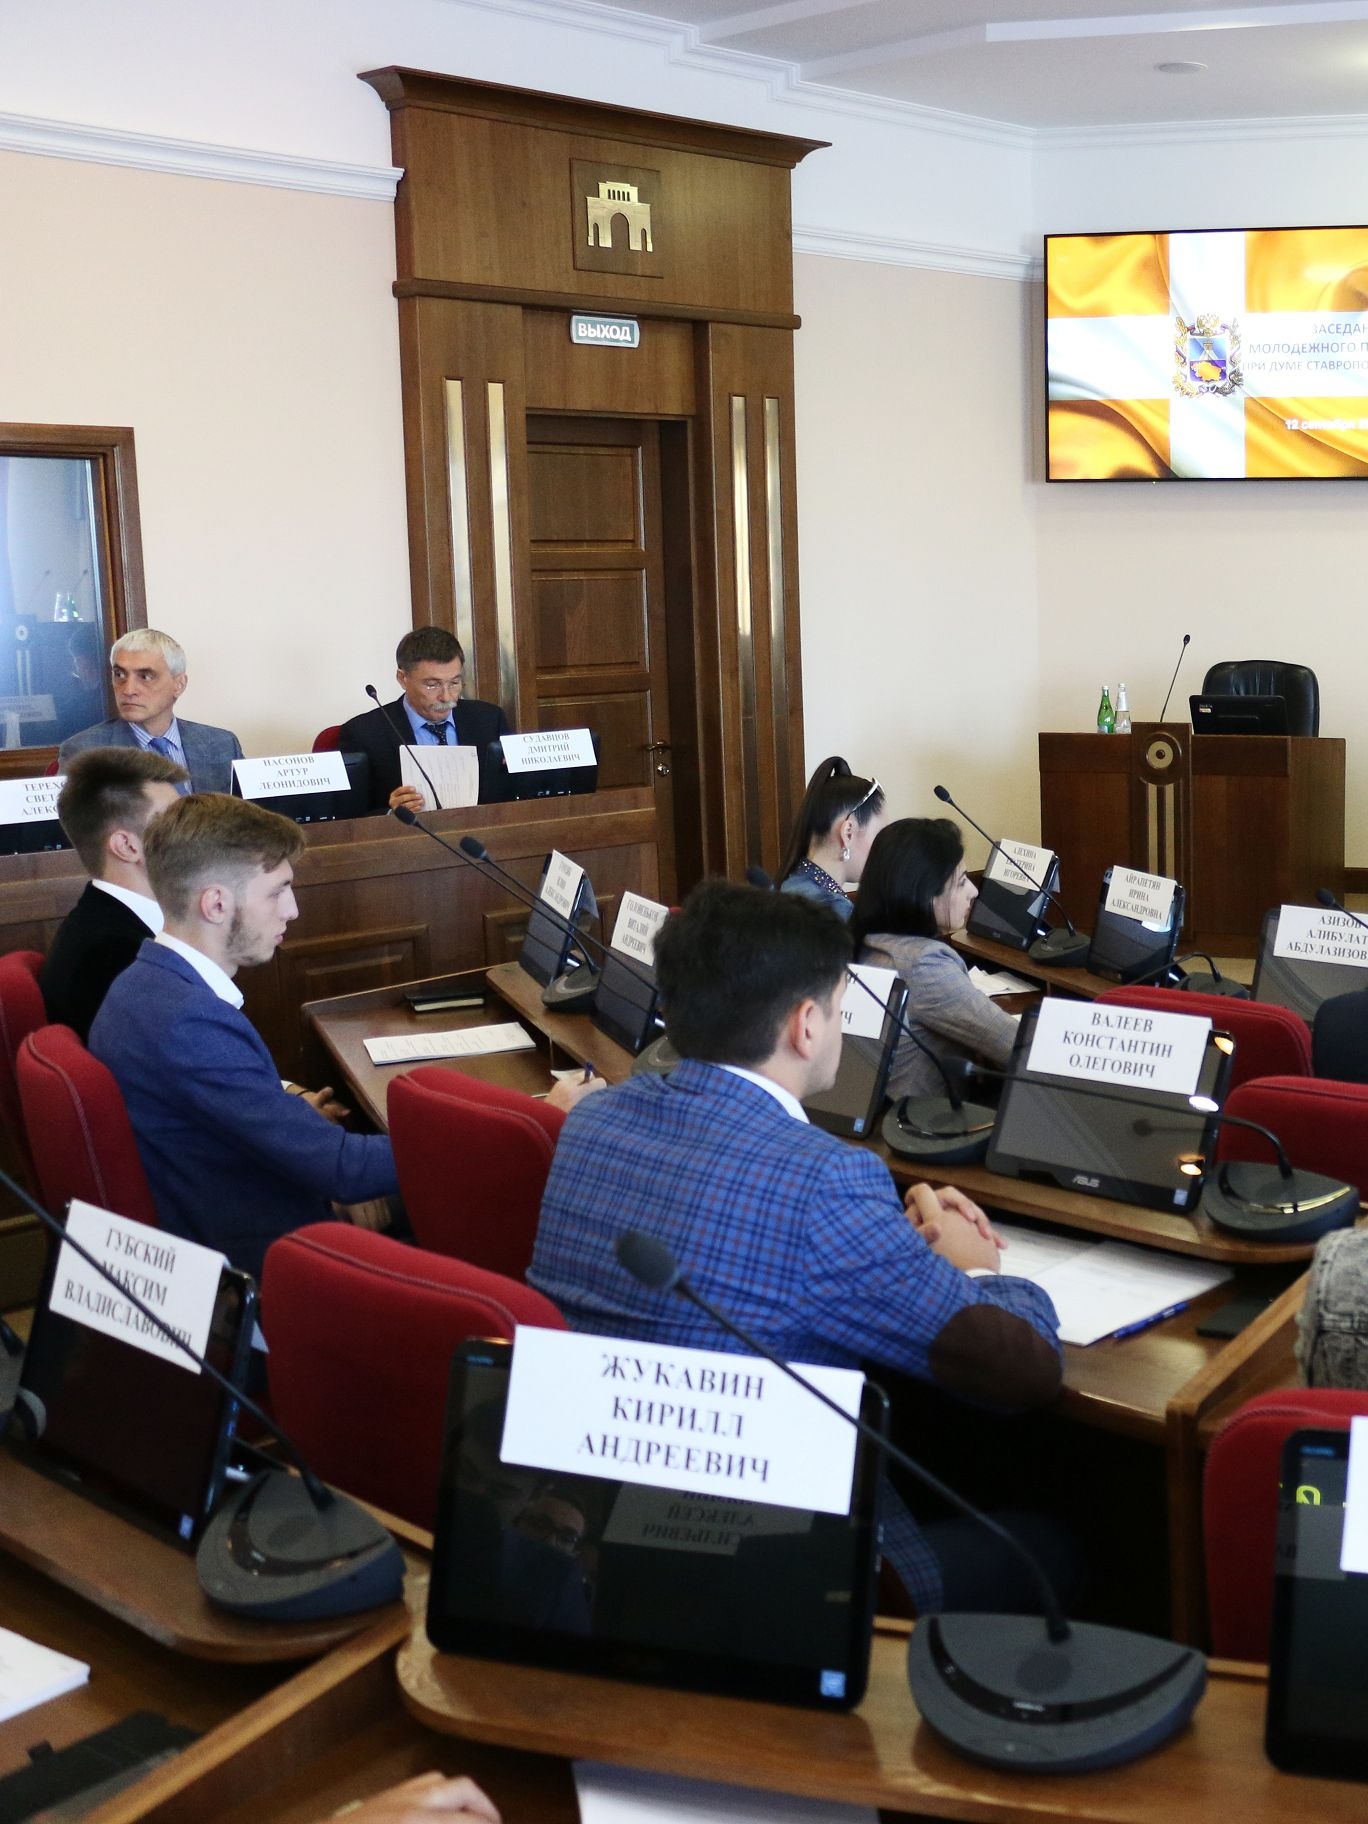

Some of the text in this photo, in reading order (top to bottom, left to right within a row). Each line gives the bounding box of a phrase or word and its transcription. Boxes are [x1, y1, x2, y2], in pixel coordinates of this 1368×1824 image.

[577, 322, 632, 342] ВЫХОД
[1249, 342, 1356, 355] МОЛОДЕЖНОГО
[1242, 361, 1266, 371] ПРИ
[1269, 361, 1303, 372] ДУМЕ
[1286, 419, 1299, 430] 12
[528, 743, 570, 755] ДМИТРИЙ
[263, 756, 316, 767] НАСОНОВ
[521, 753, 581, 765] НИКОЛАЕВИЧ
[277, 767, 309, 777] АРТУР
[260, 777, 332, 790] ЛЕОНИДОВИЧ
[25, 793, 55, 803] СВЕТ
[1126, 873, 1161, 891] АЙРАПЕТЯН
[1129, 889, 1149, 902] ИРИНА
[1111, 899, 1162, 920] АЛЕКСАНДРОВНА
[1319, 915, 1362, 929] АЗИЗОВ
[1306, 929, 1368, 945] АЛИБУЛАТ
[1091, 1012, 1153, 1033] ВАЛЕЕВ
[1062, 1030, 1173, 1058] КОНСТАНТИН
[1069, 1053, 1156, 1079] ОЛЕГОВИЧ
[1072, 1175, 1100, 1188] ASUS
[106, 1228, 176, 1274] ГУБСКИЙ
[600, 1352, 767, 1402] ЖУКАВИН
[611, 1395, 746, 1440] КИРИЛЛ
[577, 1431, 772, 1485] АНДРЕЕВИЧ
